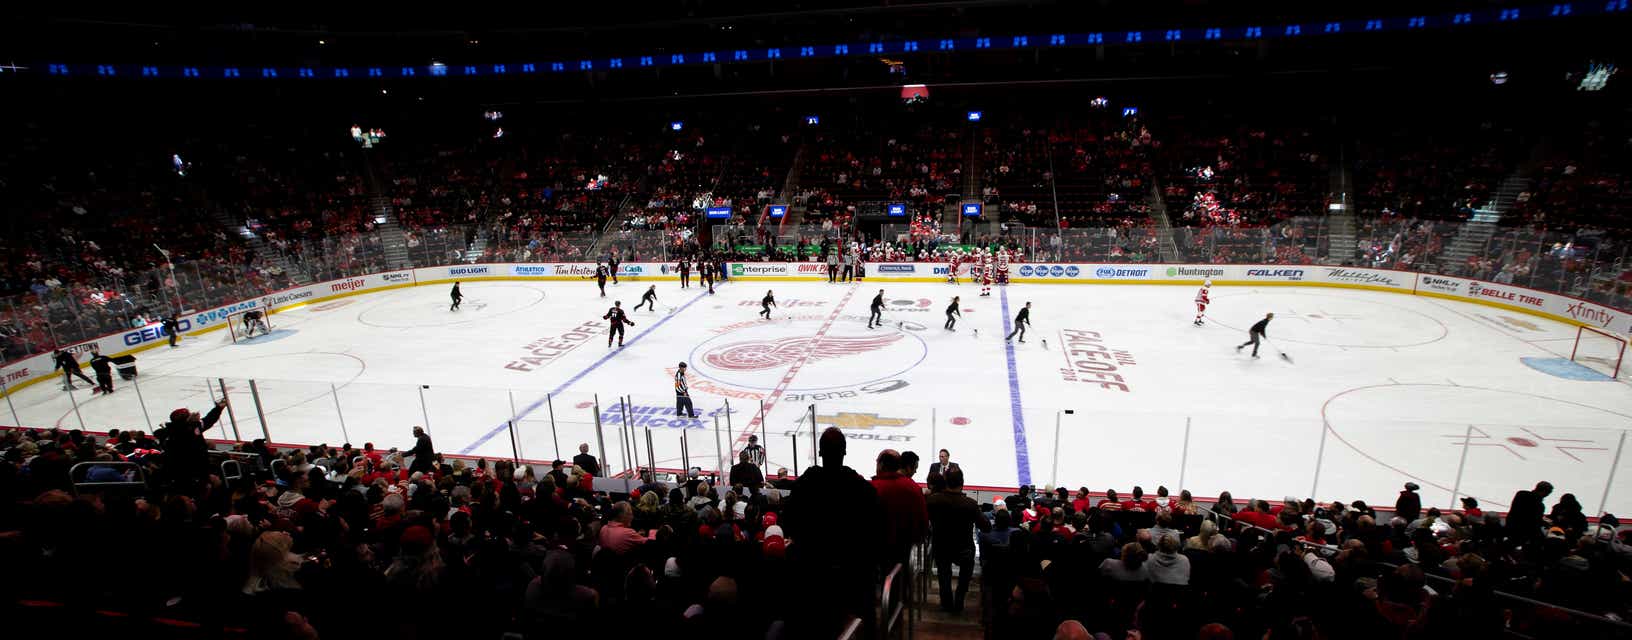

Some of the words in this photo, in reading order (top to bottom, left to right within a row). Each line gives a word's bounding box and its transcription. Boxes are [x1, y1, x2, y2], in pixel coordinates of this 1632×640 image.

[554, 264, 569, 275] Tim
[569, 264, 598, 275] Horton
[624, 265, 642, 273] Cash
[734, 266, 786, 274] enterprise
[933, 267, 949, 275] DM
[1116, 269, 1148, 277] DETROIT
[1178, 267, 1223, 278] Huntington
[1247, 269, 1304, 277] FALKEN
[331, 278, 365, 291] meijer
[272, 295, 289, 305] Little
[1481, 288, 1516, 300] BELLE
[1519, 294, 1544, 306] TIRE
[1565, 301, 1614, 328] xfinity
[783, 390, 859, 401] arena
[599, 412, 708, 430] Wilcox
